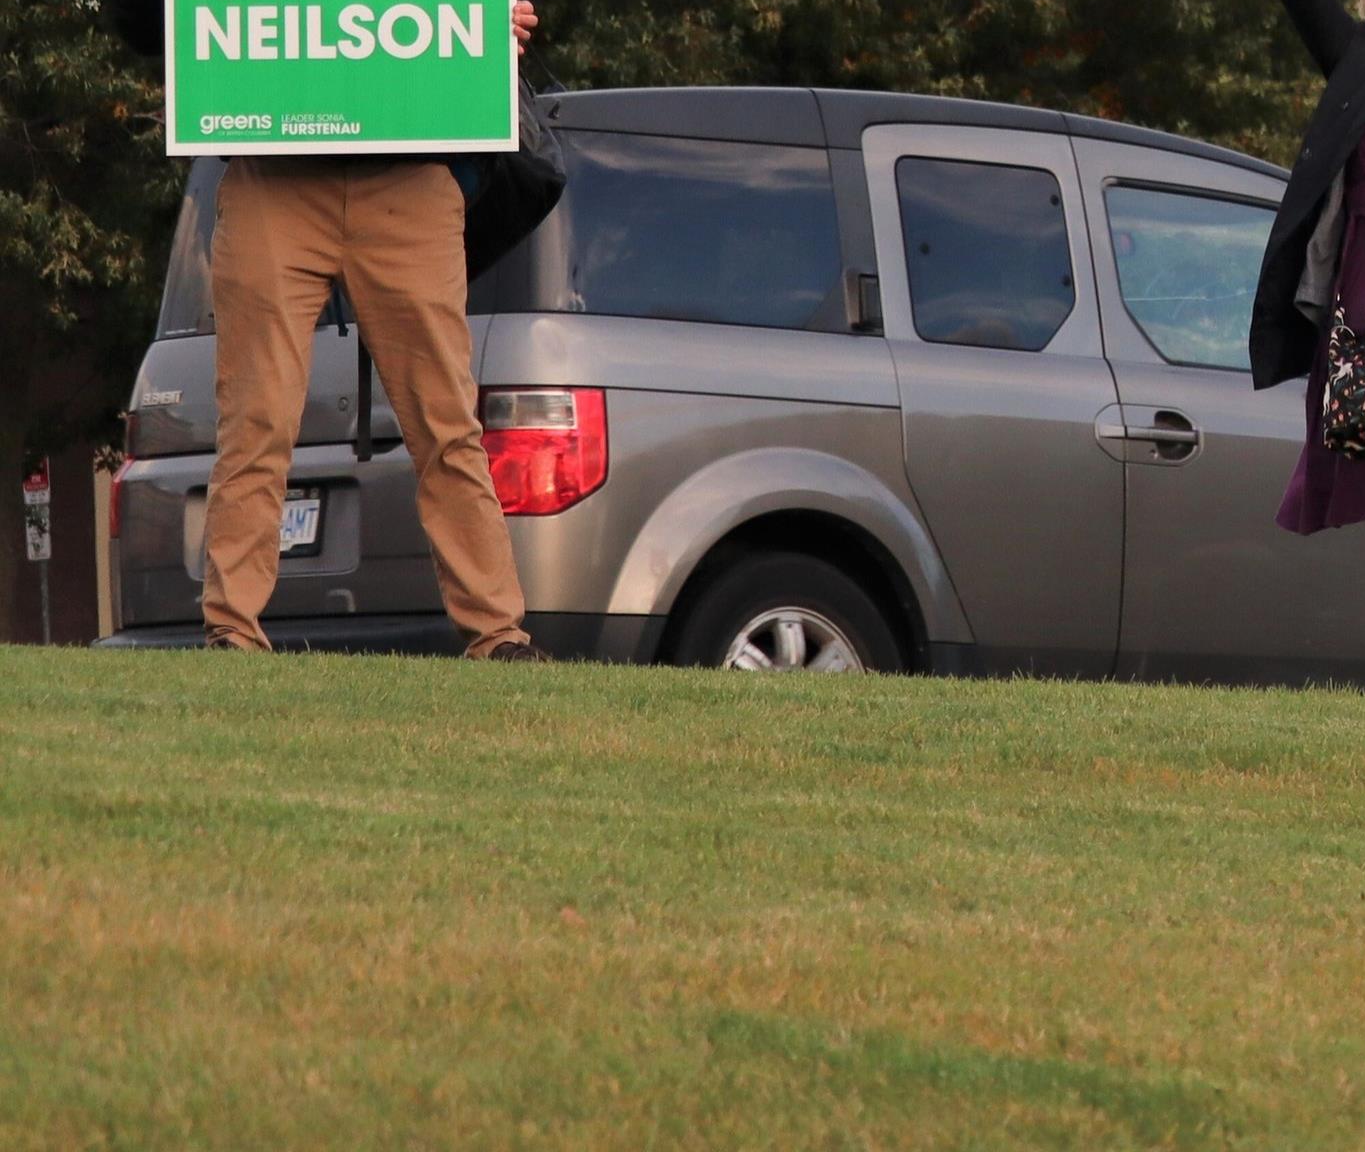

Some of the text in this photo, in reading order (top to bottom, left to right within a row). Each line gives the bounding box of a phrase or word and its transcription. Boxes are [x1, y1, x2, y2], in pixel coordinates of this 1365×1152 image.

[196, 3, 483, 60] NEILSON
[200, 114, 272, 135] greens
[281, 122, 361, 135] FURSTENAU
